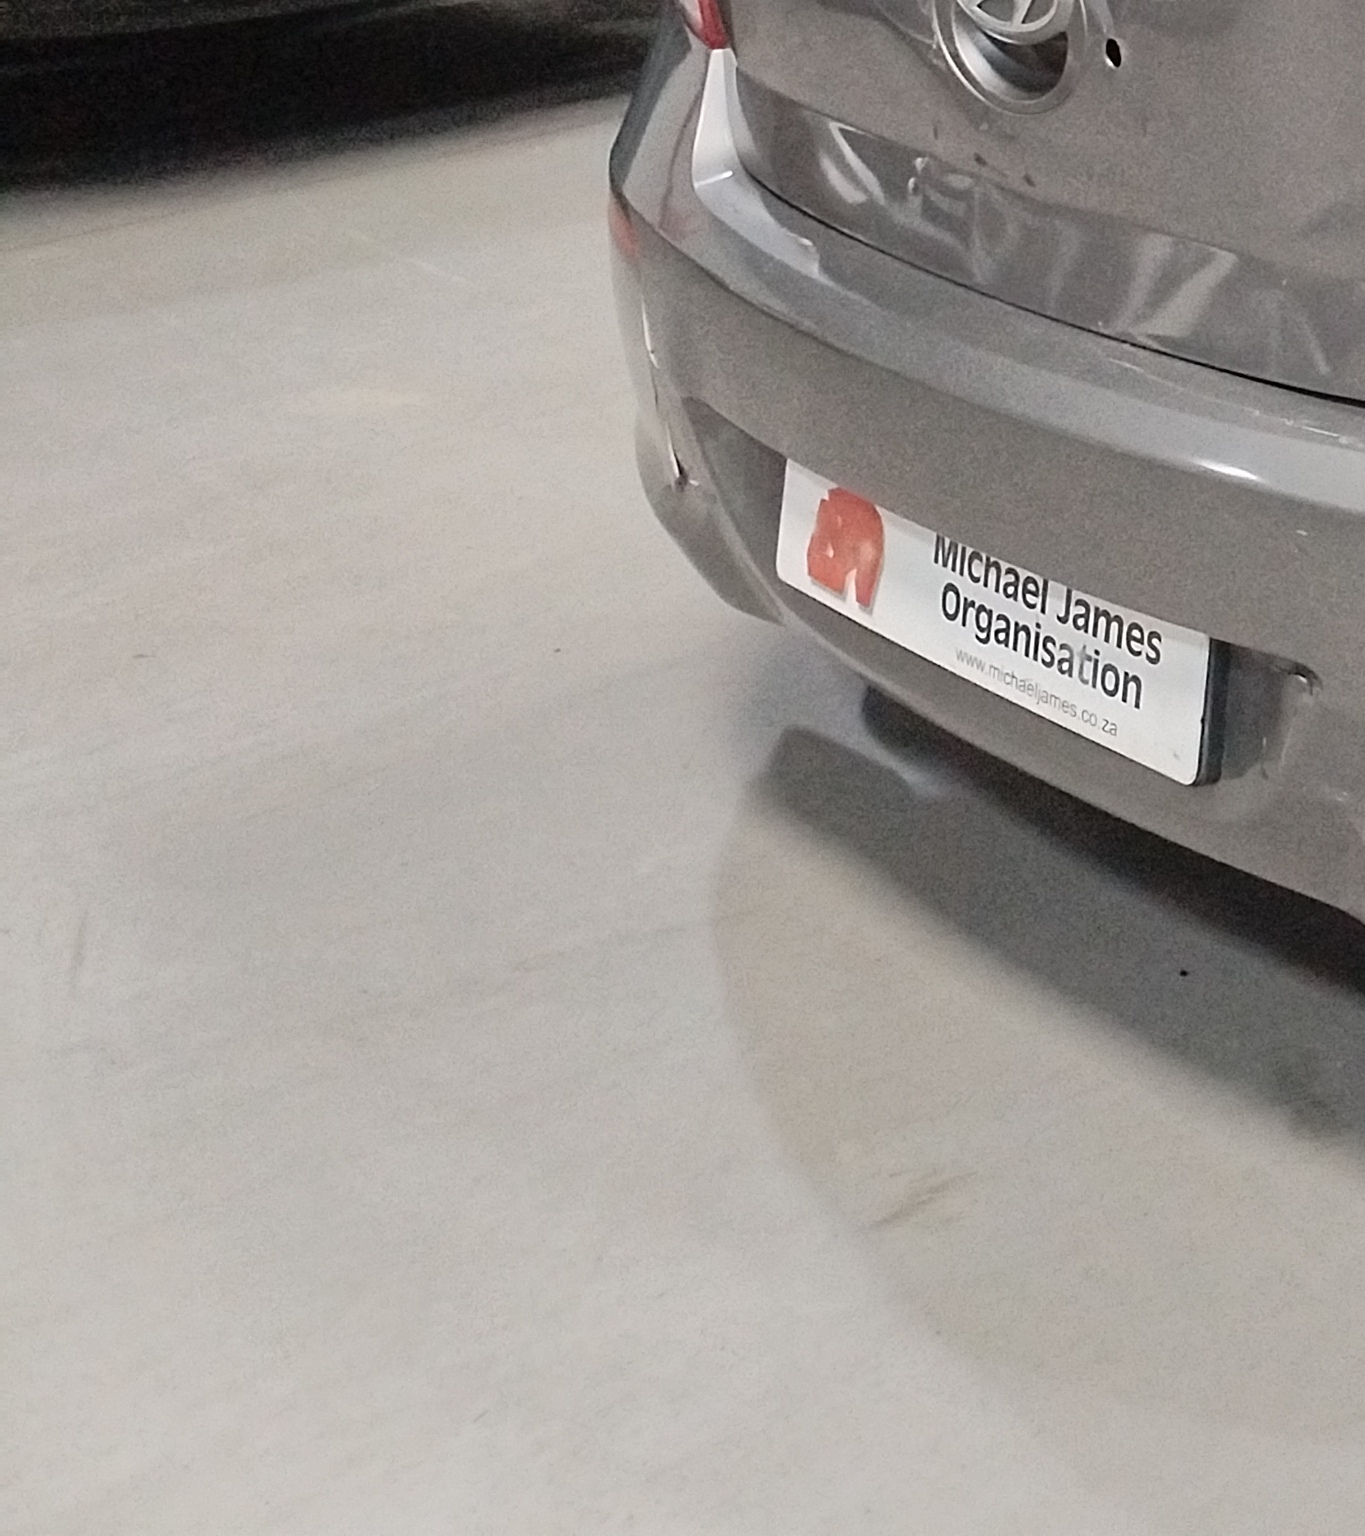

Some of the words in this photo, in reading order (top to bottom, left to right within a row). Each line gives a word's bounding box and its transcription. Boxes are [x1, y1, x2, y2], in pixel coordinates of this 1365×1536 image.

[934, 534, 1049, 614] Michael
[1056, 587, 1163, 665] James
[941, 582, 1143, 710] Organisation
[955, 647, 1119, 737] www.michaeljames.co.za
